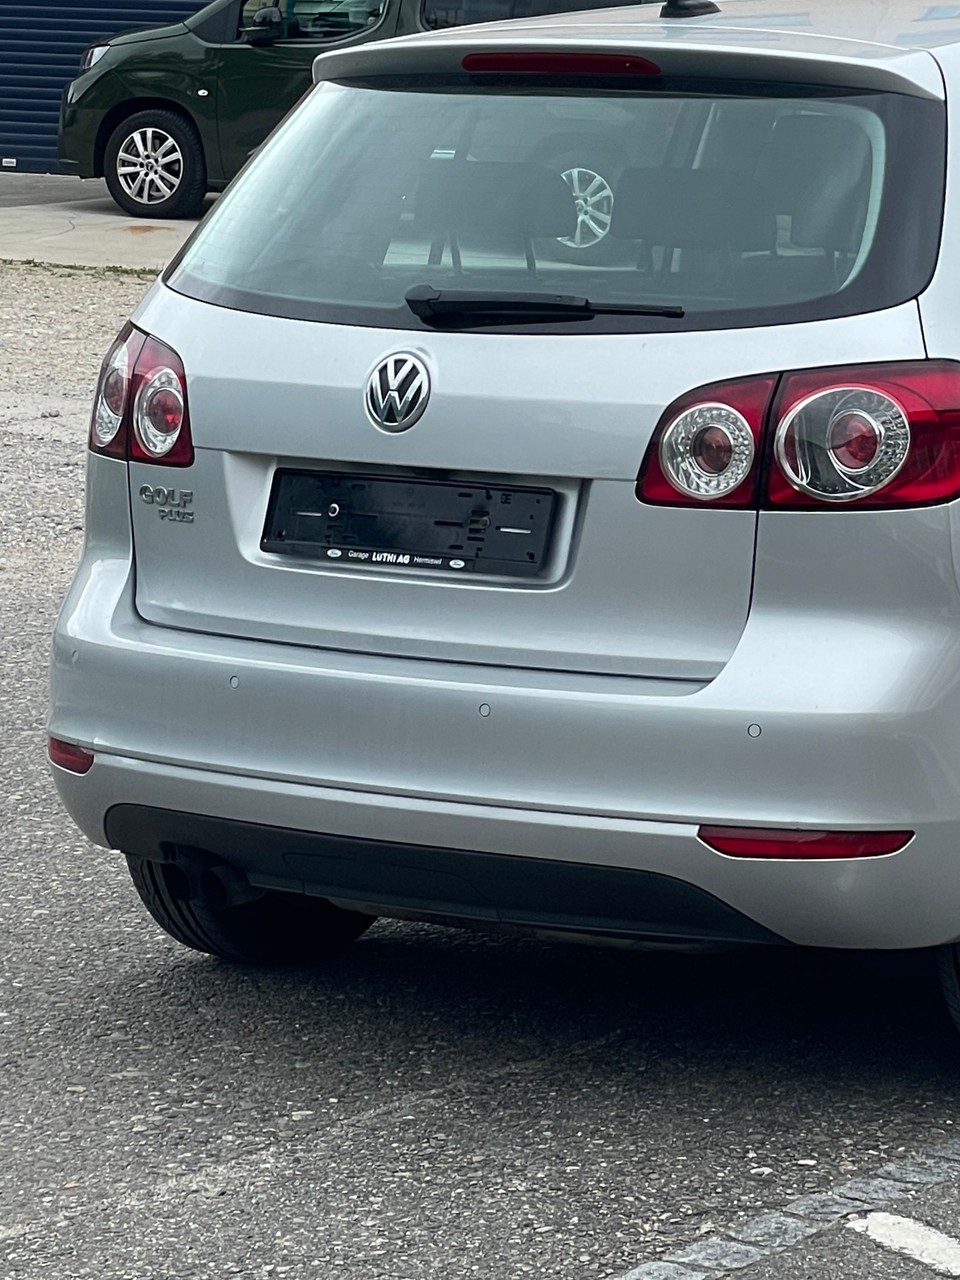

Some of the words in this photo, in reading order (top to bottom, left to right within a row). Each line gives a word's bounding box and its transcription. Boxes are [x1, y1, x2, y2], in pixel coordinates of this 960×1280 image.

[139, 484, 194, 508] GOLF
[158, 507, 195, 523] PLUS
[348, 550, 369, 560] Garage
[397, 554, 411, 564] AG
